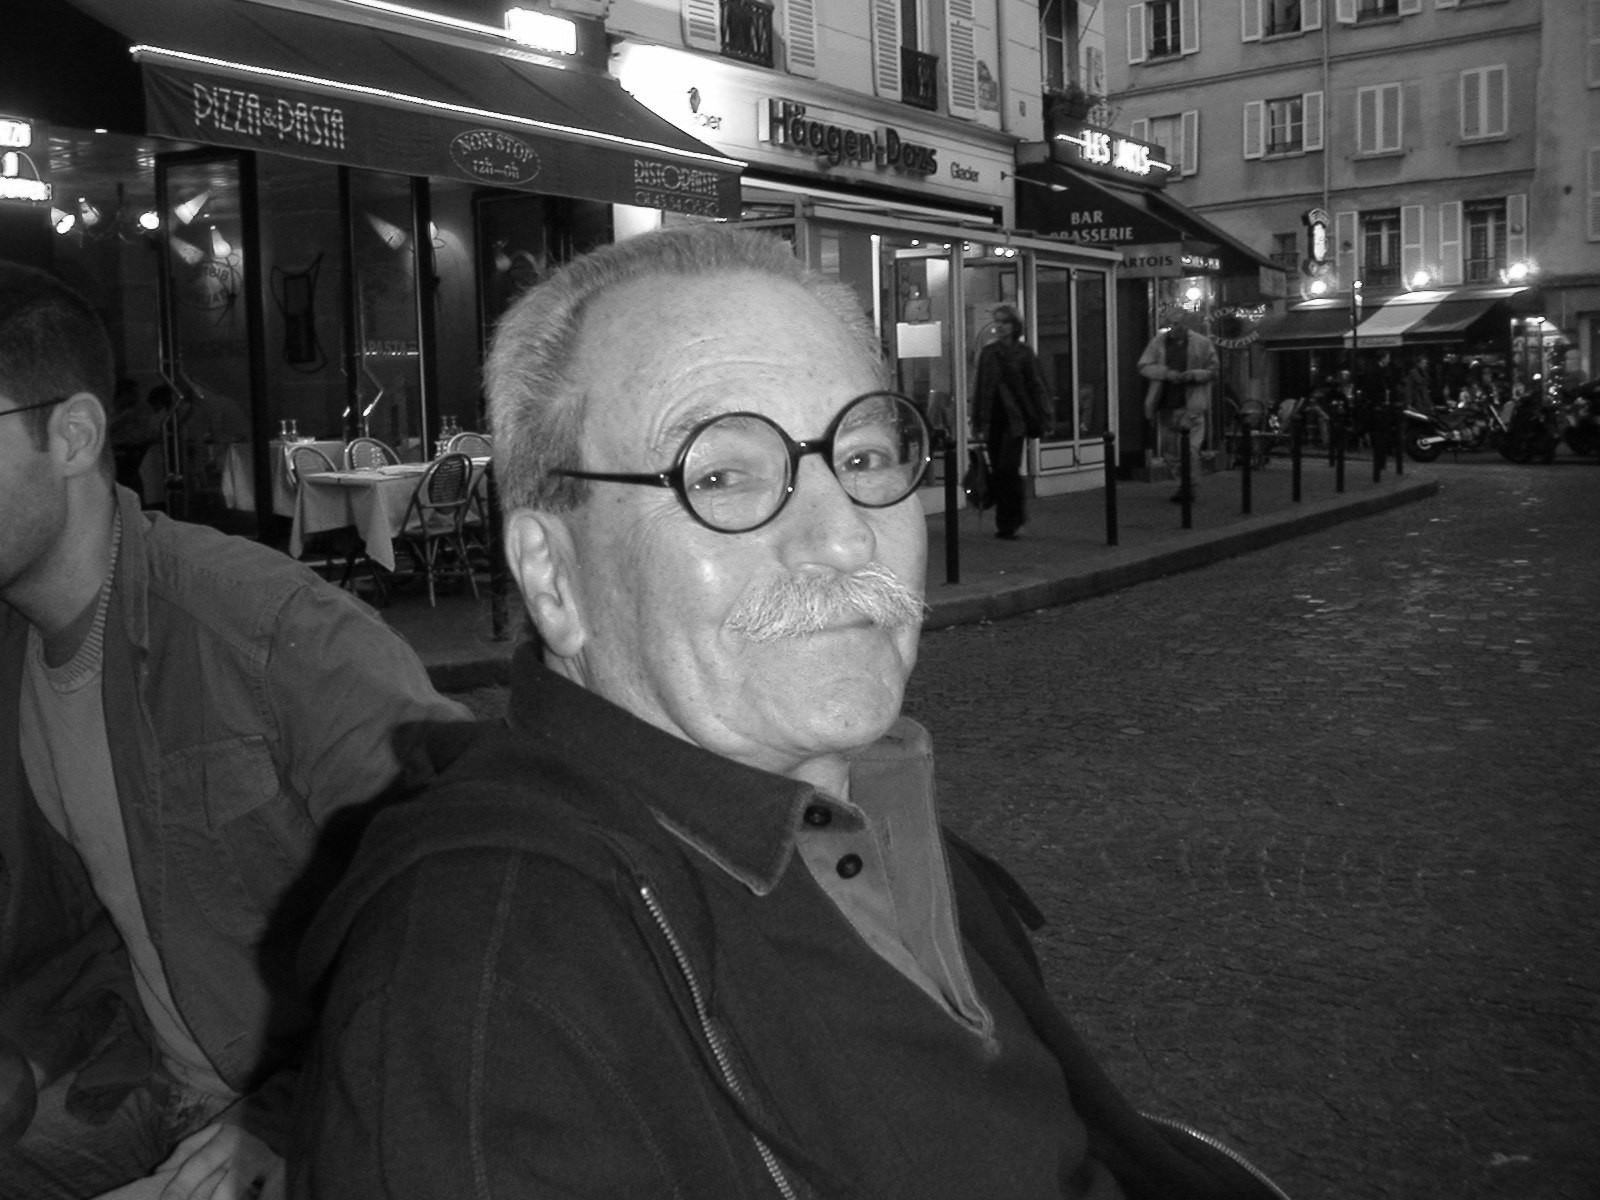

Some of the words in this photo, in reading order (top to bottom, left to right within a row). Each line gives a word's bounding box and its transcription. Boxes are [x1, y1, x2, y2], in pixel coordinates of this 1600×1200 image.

[457, 132, 493, 155] NON
[495, 134, 534, 163] STOP
[950, 161, 981, 183] Glacier
[1070, 210, 1104, 225] BAR
[1118, 255, 1173, 269] ARTOIS
